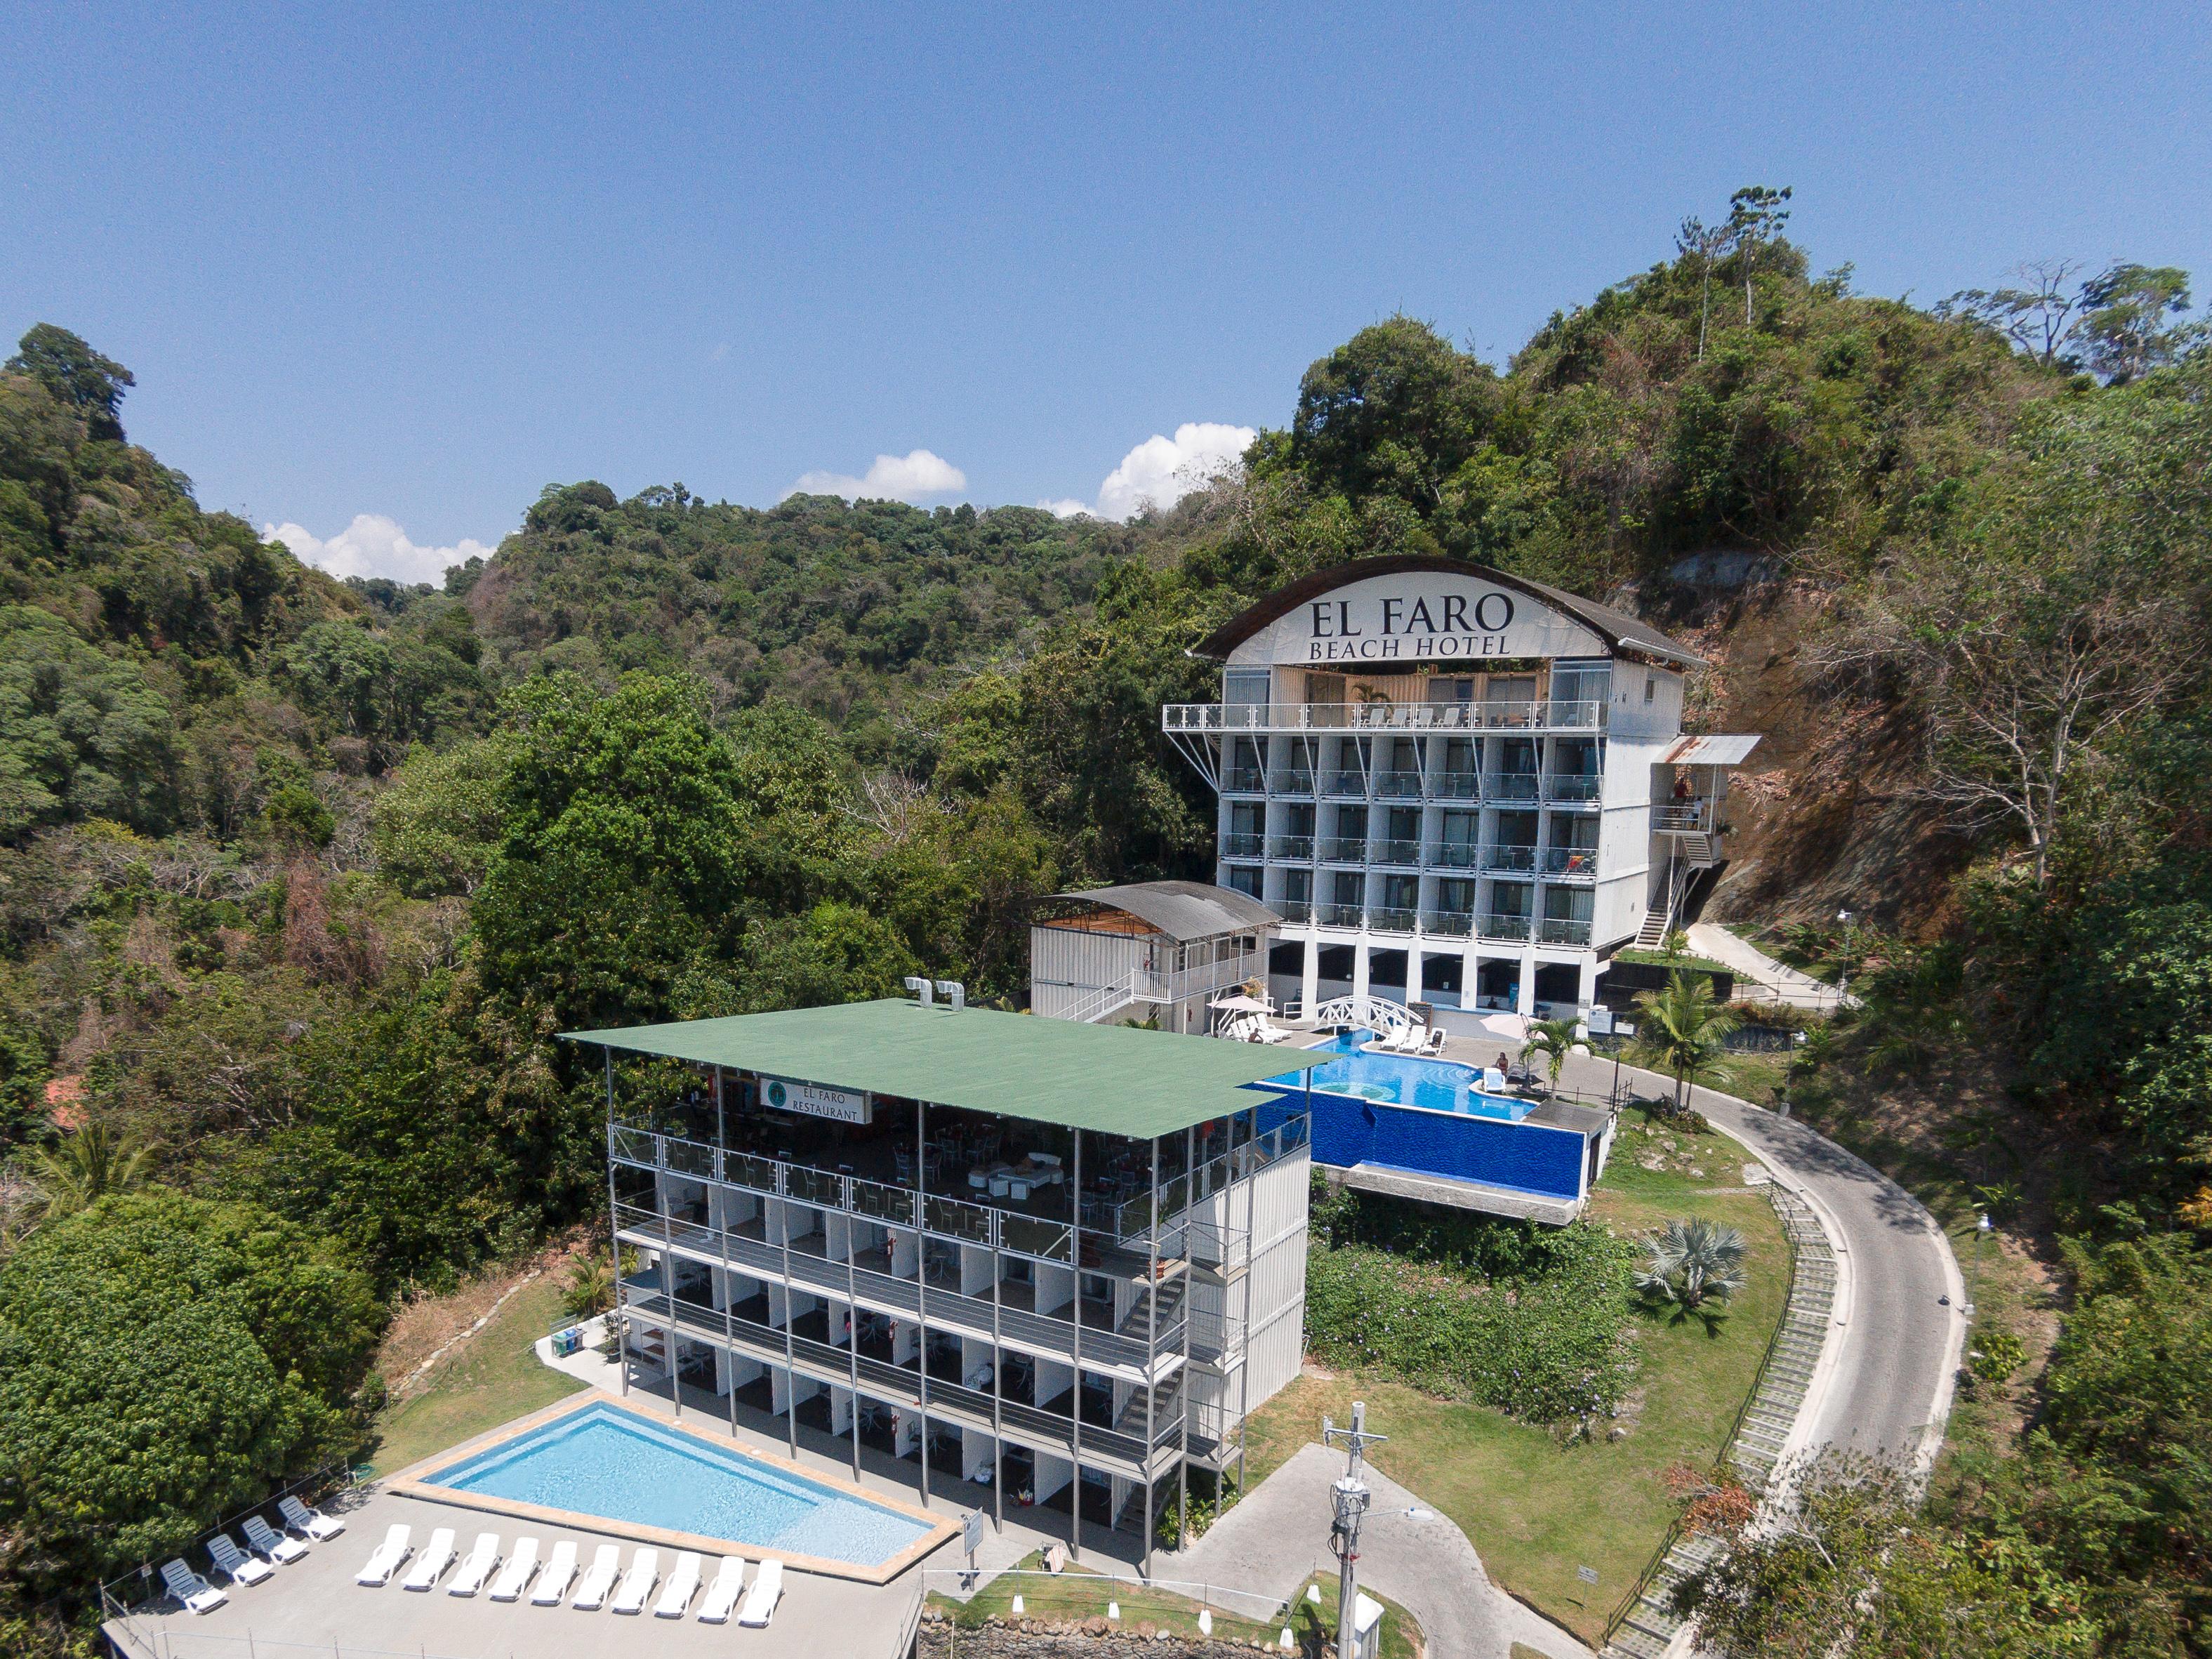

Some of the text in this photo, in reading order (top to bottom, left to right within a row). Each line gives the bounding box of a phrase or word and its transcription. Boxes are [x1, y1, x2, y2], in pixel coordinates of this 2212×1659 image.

[1309, 593, 1514, 637] EL FARO
[1310, 635, 1510, 659] BEACH HOTEL
[804, 1088, 845, 1104] EL FARO
[793, 1100, 857, 1121] RESTAURANT
